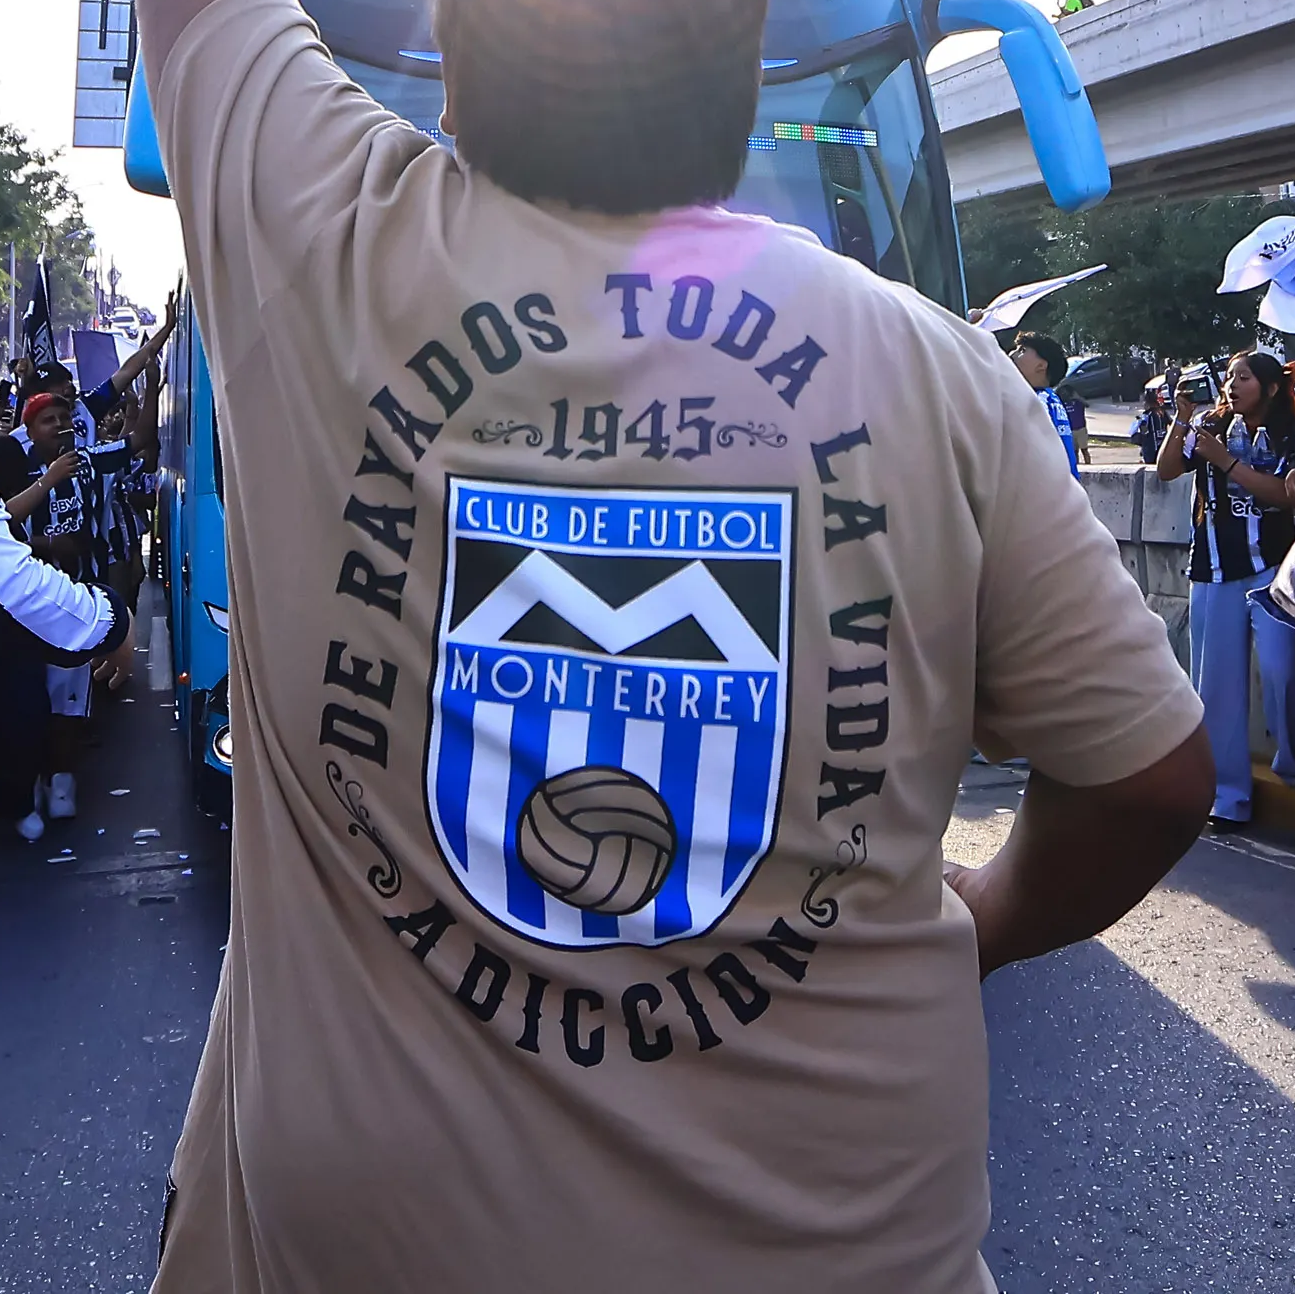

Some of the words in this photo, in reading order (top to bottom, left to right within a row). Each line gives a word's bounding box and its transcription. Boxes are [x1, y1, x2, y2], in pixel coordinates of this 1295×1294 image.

[604, 273, 828, 410] TODA
[336, 292, 568, 621] RAYADOS
[542, 396, 717, 463] 1945
[809, 422, 888, 553] LA
[44, 517, 83, 536] coder
[464, 495, 550, 540] CLUB
[567, 505, 610, 546] DE
[627, 506, 775, 551] FUTBOL
[319, 640, 399, 769] DE
[449, 648, 771, 723] MONTERREY
[817, 595, 894, 823] VIDA
[383, 898, 819, 1069] ADICCION
